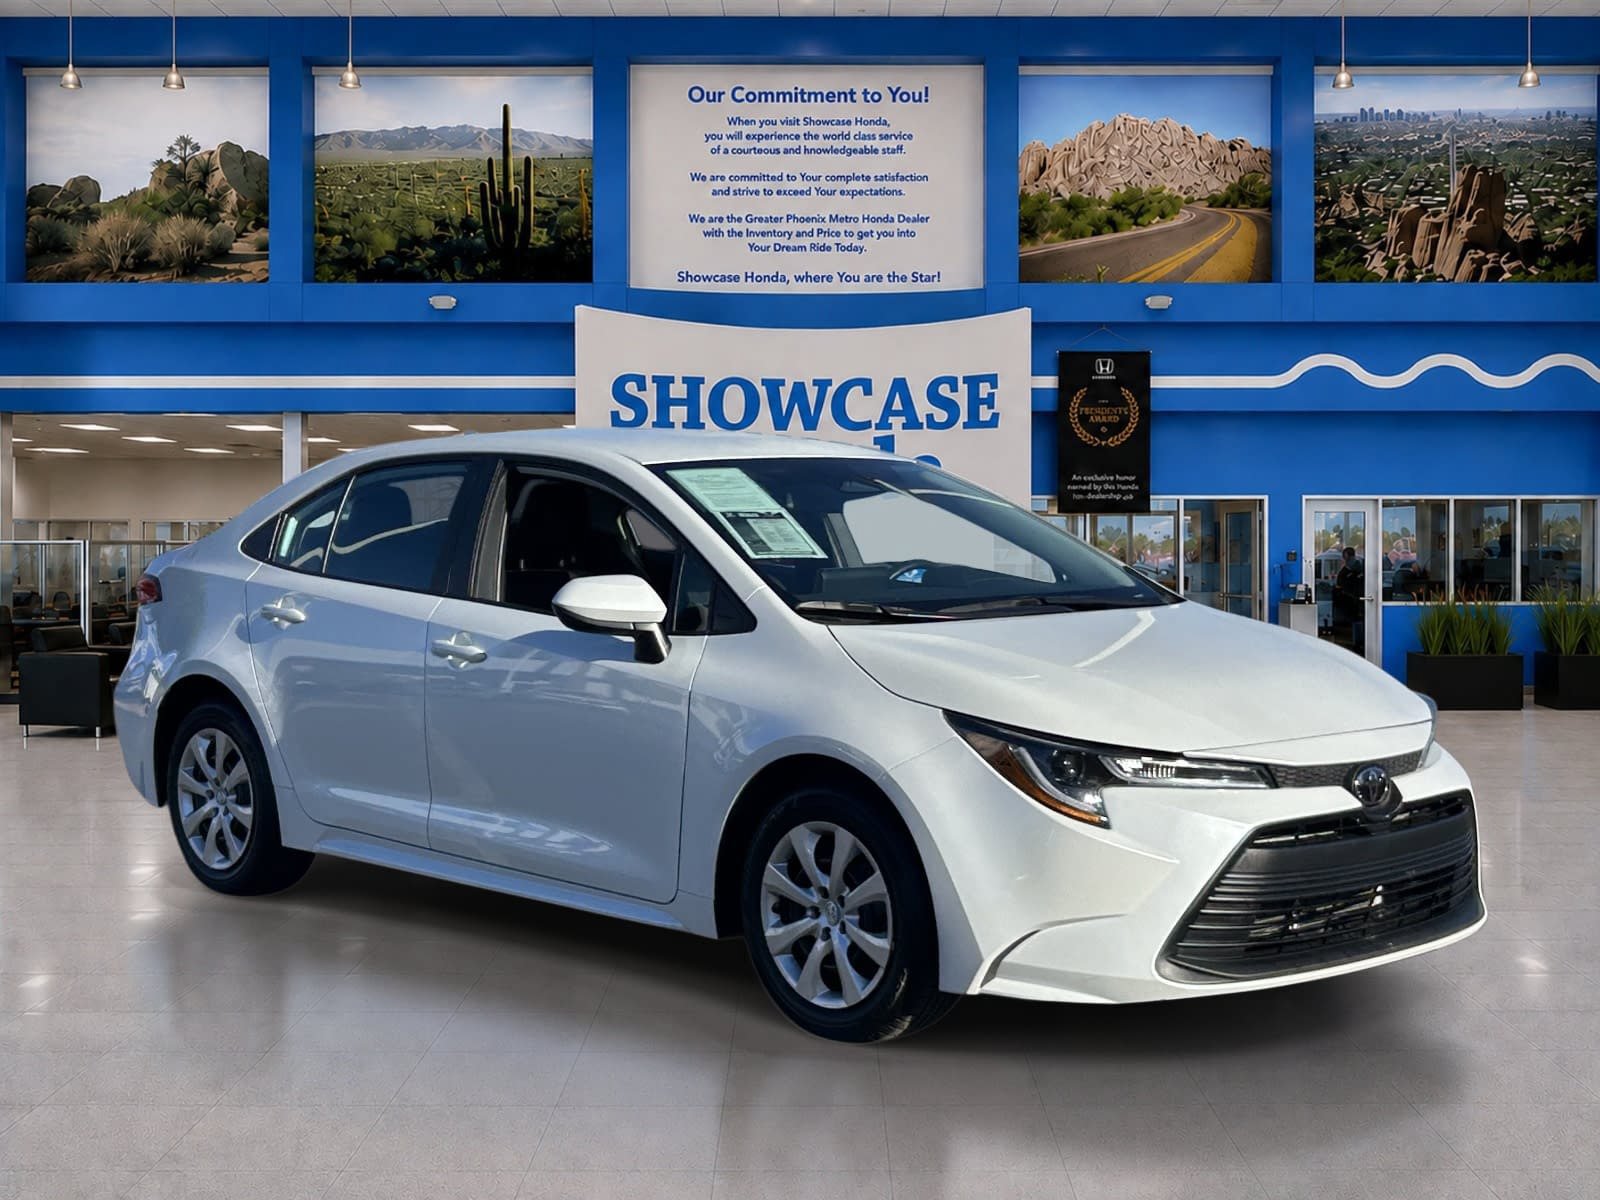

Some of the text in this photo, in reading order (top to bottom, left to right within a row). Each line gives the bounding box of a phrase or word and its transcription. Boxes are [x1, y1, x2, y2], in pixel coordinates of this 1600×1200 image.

[687, 85, 930, 104] Our Commitment to You!
[726, 115, 891, 129] When you visit Showcase Honda,
[704, 130, 914, 144] you will experience the world class service
[709, 144, 721, 155] of
[722, 147, 730, 155] a
[730, 146, 782, 156] courteous
[782, 144, 802, 155] and
[881, 144, 907, 155] staff.
[689, 171, 929, 185] We are committed to Your complete satisfaction
[711, 185, 906, 200] and strive to exceed Your expectations.
[688, 213, 931, 224] We are the Greater Phoenix Metro Honda Dealer
[702, 227, 917, 241] with the Inventory and Price to get you into
[747, 242, 868, 255] Your Dream Ride Today.
[676, 270, 941, 286] Showcase Honda, where You are the Star!
[609, 372, 1001, 431] SHOWCASE
[1071, 473, 1083, 481] An
